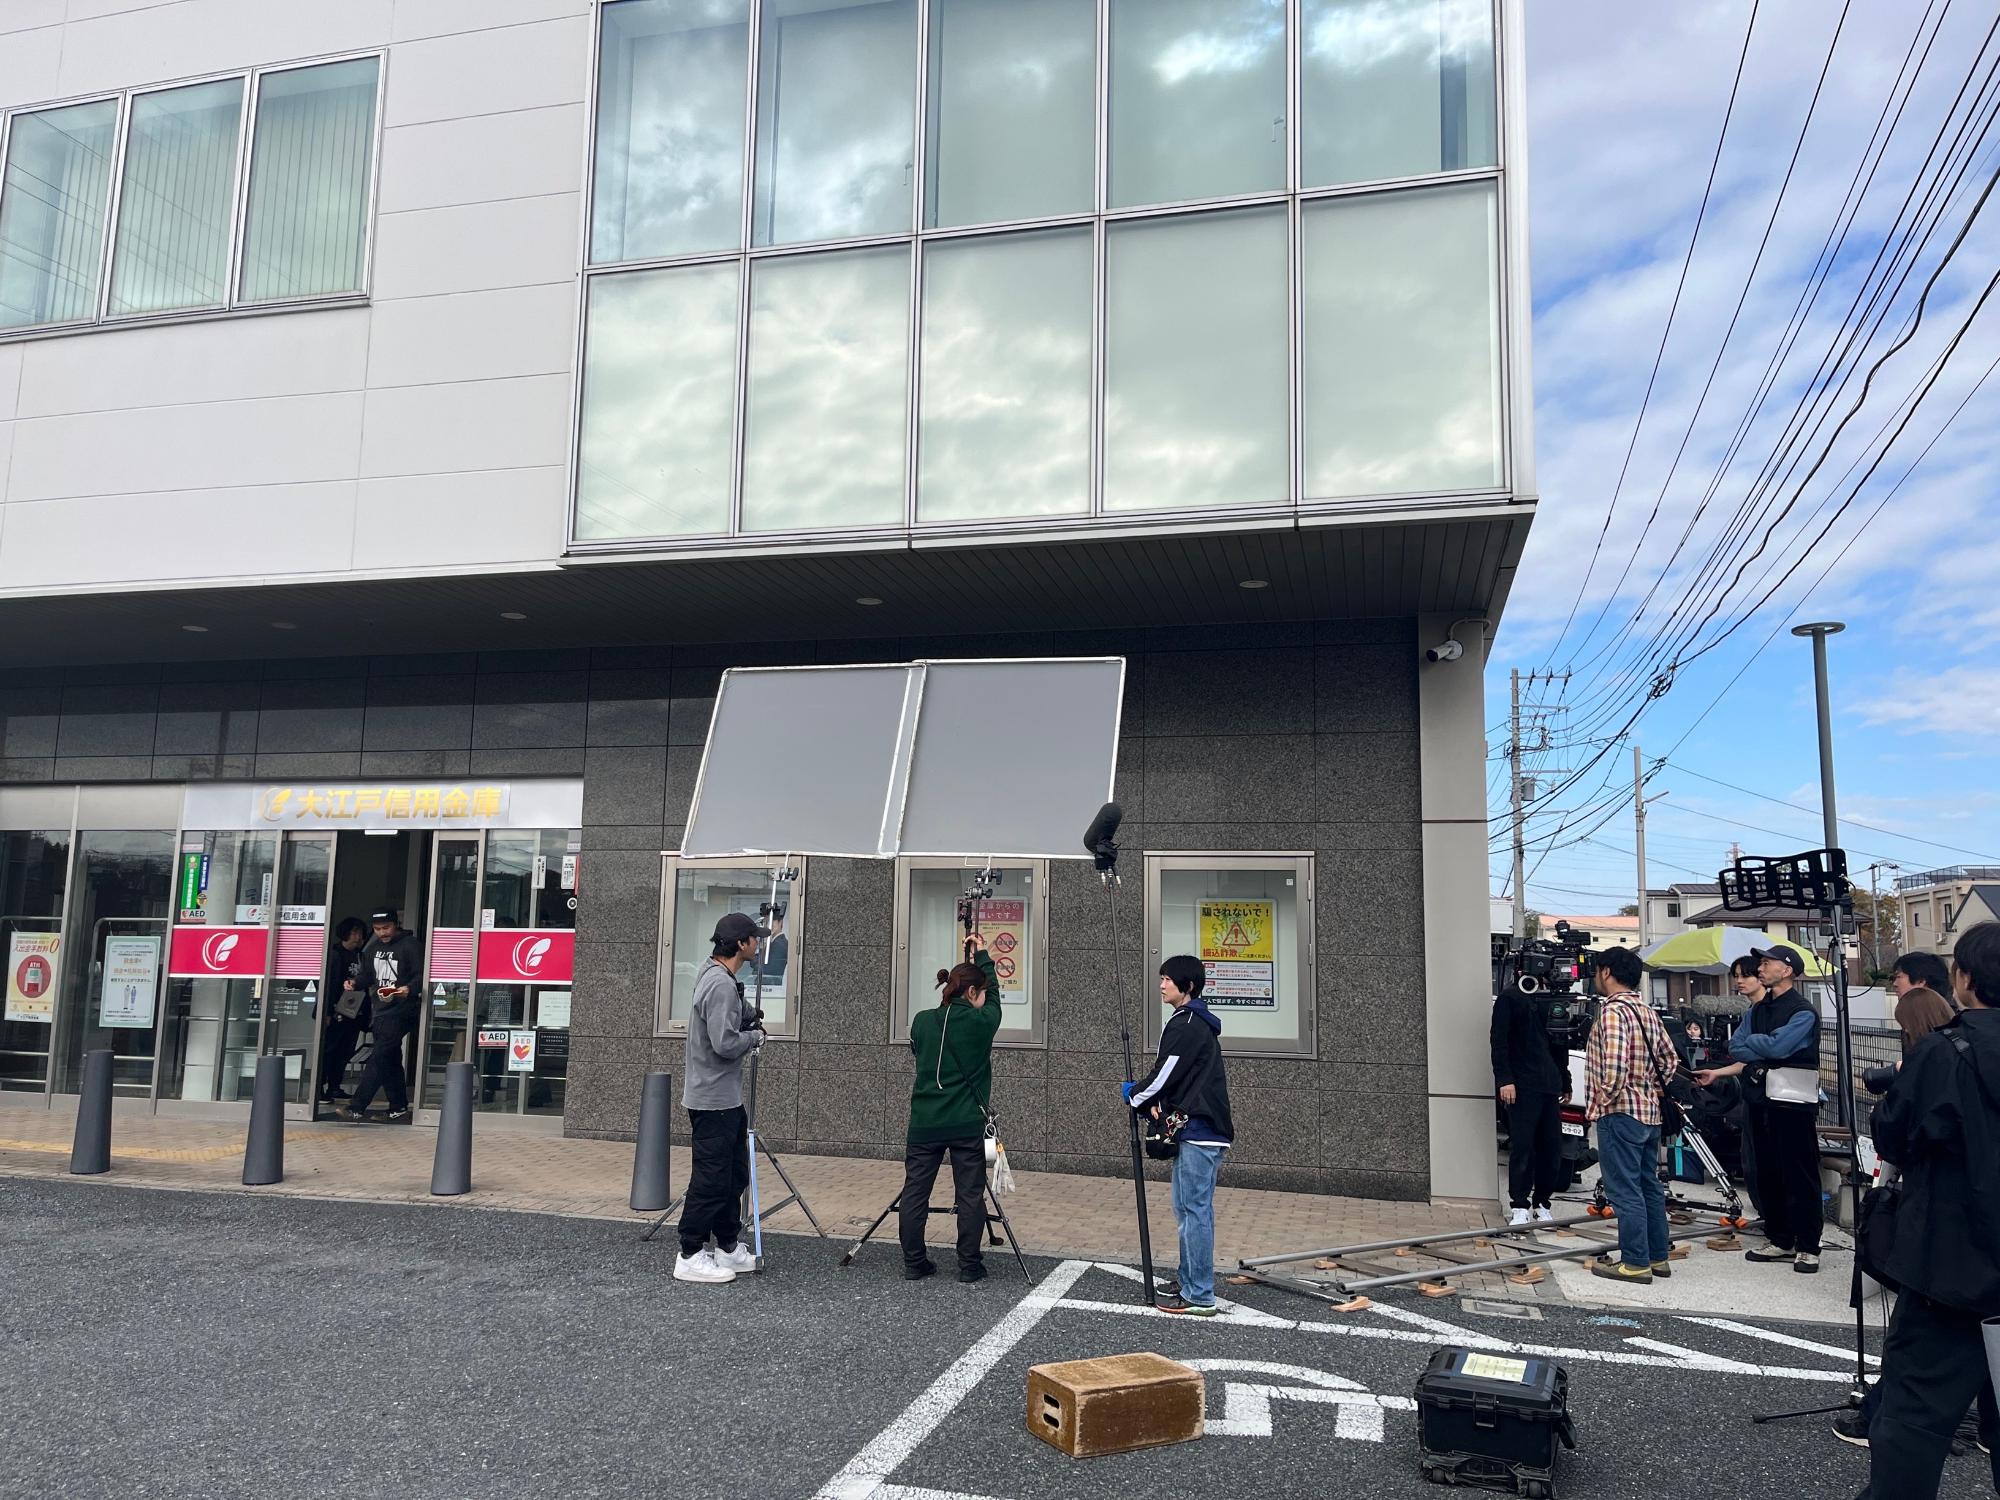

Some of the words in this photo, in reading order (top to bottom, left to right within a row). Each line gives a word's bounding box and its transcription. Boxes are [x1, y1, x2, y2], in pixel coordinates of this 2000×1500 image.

[296, 787, 502, 819] 大江戸信用金庫
[488, 1033, 506, 1041] AED
